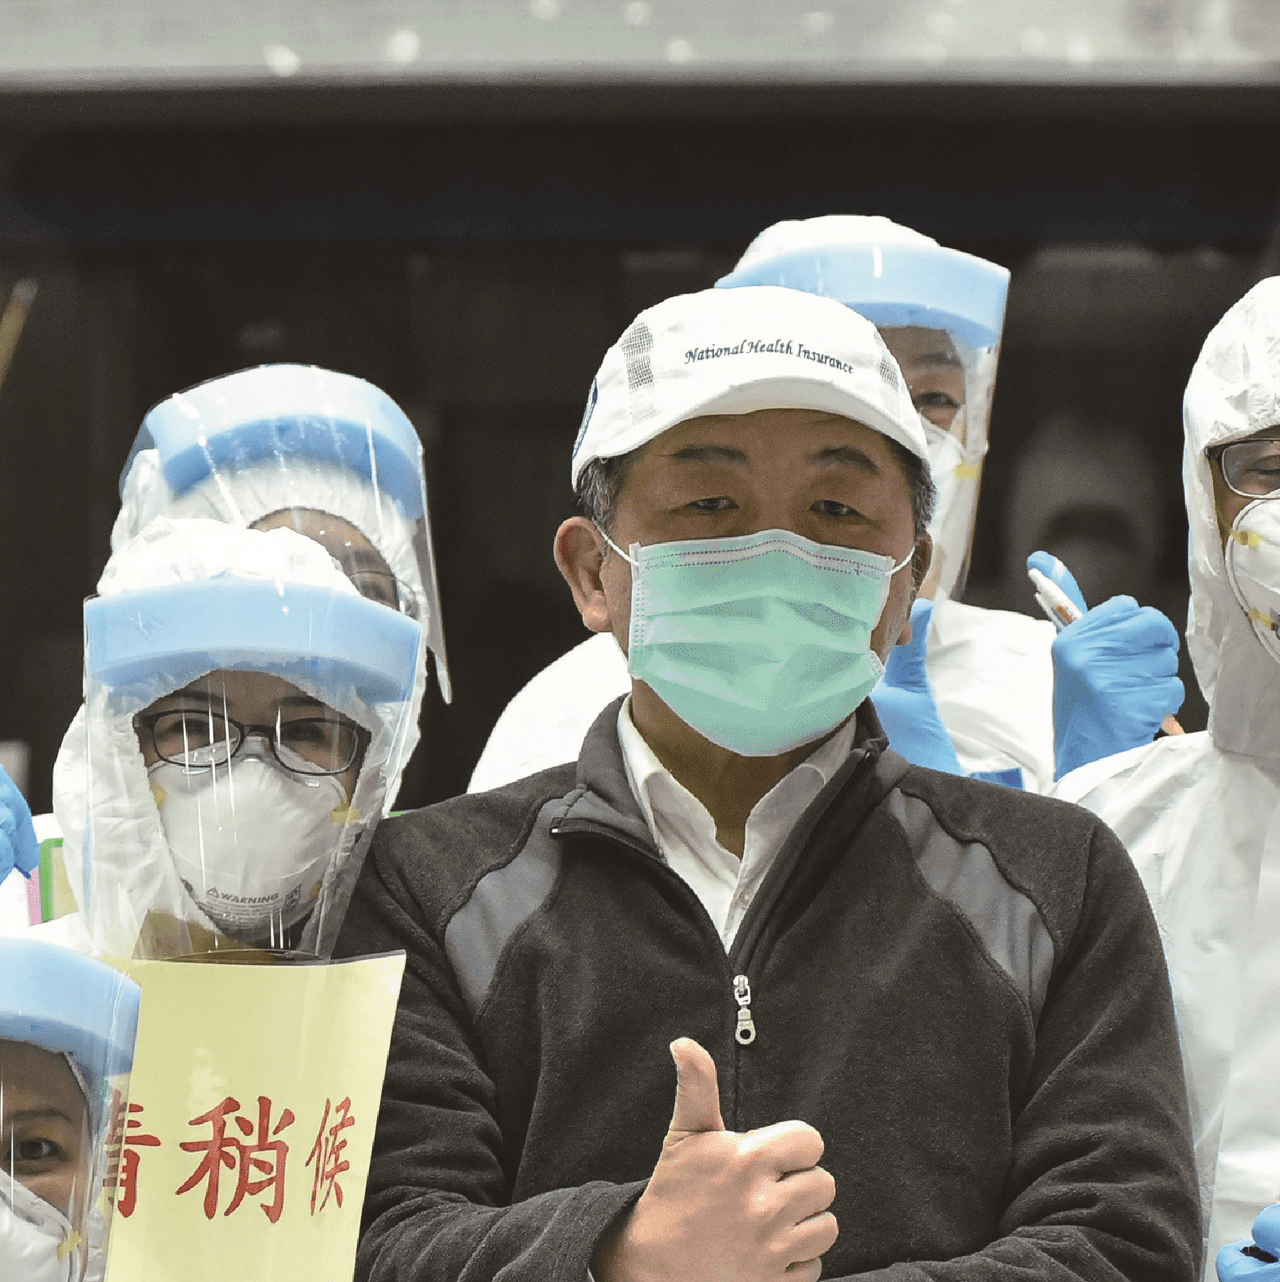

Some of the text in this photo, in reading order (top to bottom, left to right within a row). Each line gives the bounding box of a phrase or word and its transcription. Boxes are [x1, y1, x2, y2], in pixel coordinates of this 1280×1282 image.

[684, 338, 854, 374] National Health Insurance
[221, 892, 280, 904] WARNING
